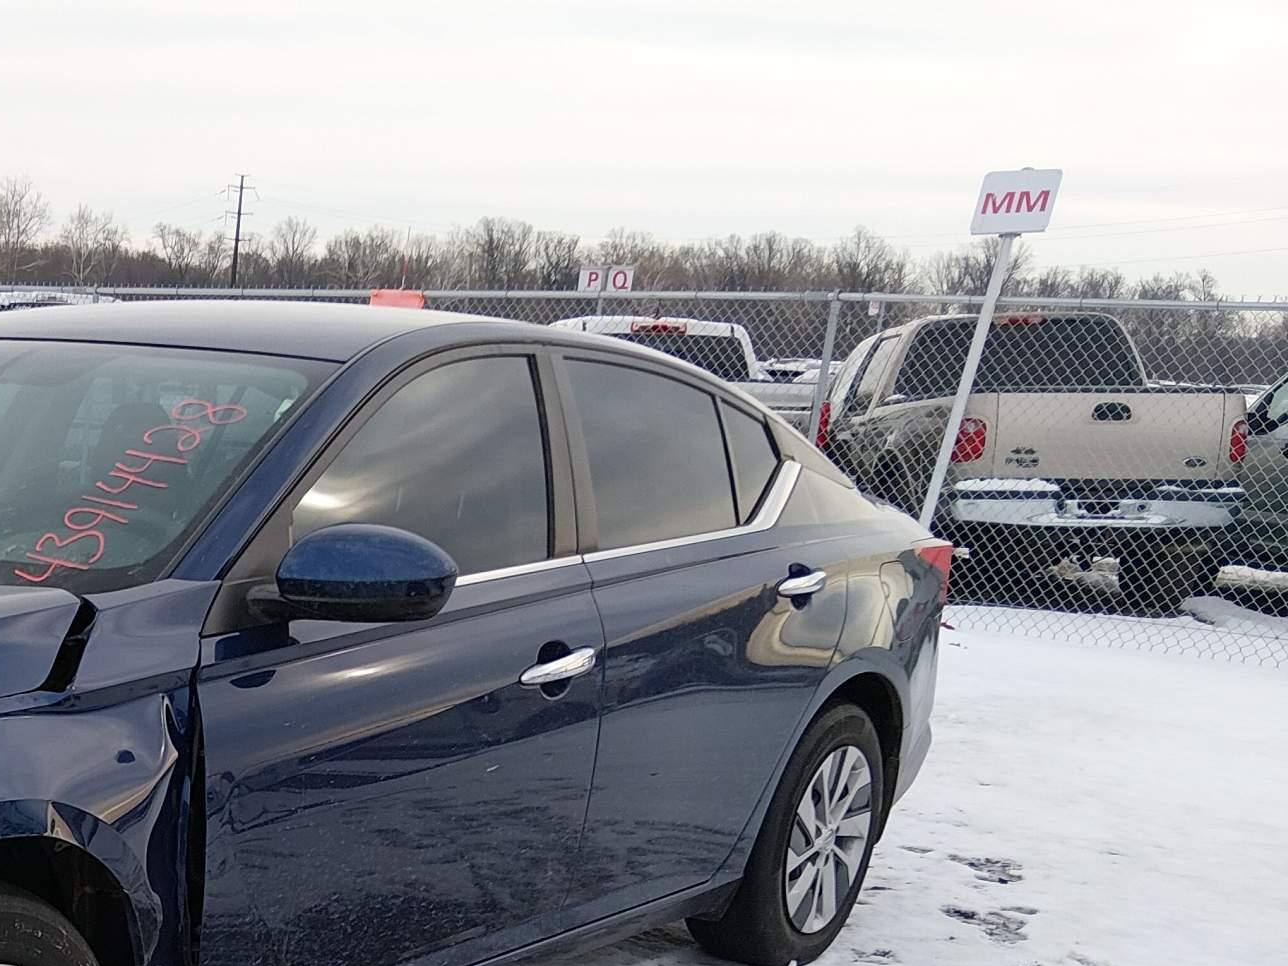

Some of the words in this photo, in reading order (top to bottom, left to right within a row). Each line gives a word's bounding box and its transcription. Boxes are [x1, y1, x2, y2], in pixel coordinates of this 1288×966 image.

[981, 190, 1051, 214] MM
[587, 271, 599, 288] P
[612, 270, 628, 290] Q
[14, 398, 247, 582] 43914428
